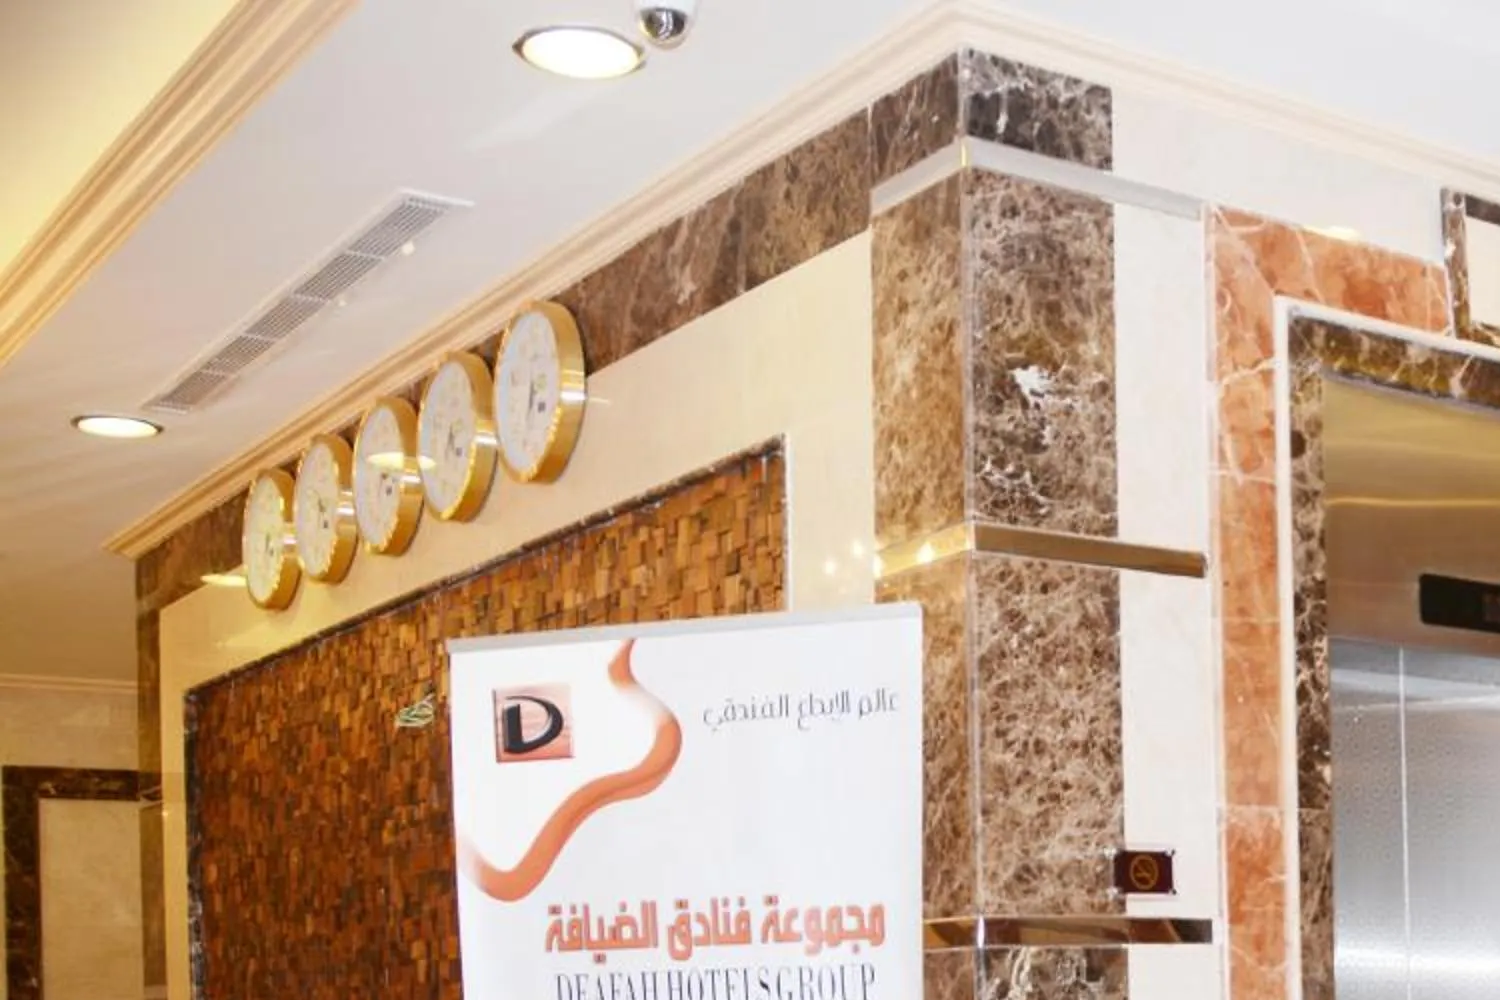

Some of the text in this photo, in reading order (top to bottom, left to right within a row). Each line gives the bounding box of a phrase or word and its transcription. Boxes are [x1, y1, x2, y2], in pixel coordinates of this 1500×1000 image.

[502, 695, 564, 754] D
[703, 693, 789, 733] الفندقي
[858, 687, 899, 720] عالم
[545, 894, 886, 965] مجموعة فنادق الضيافة
